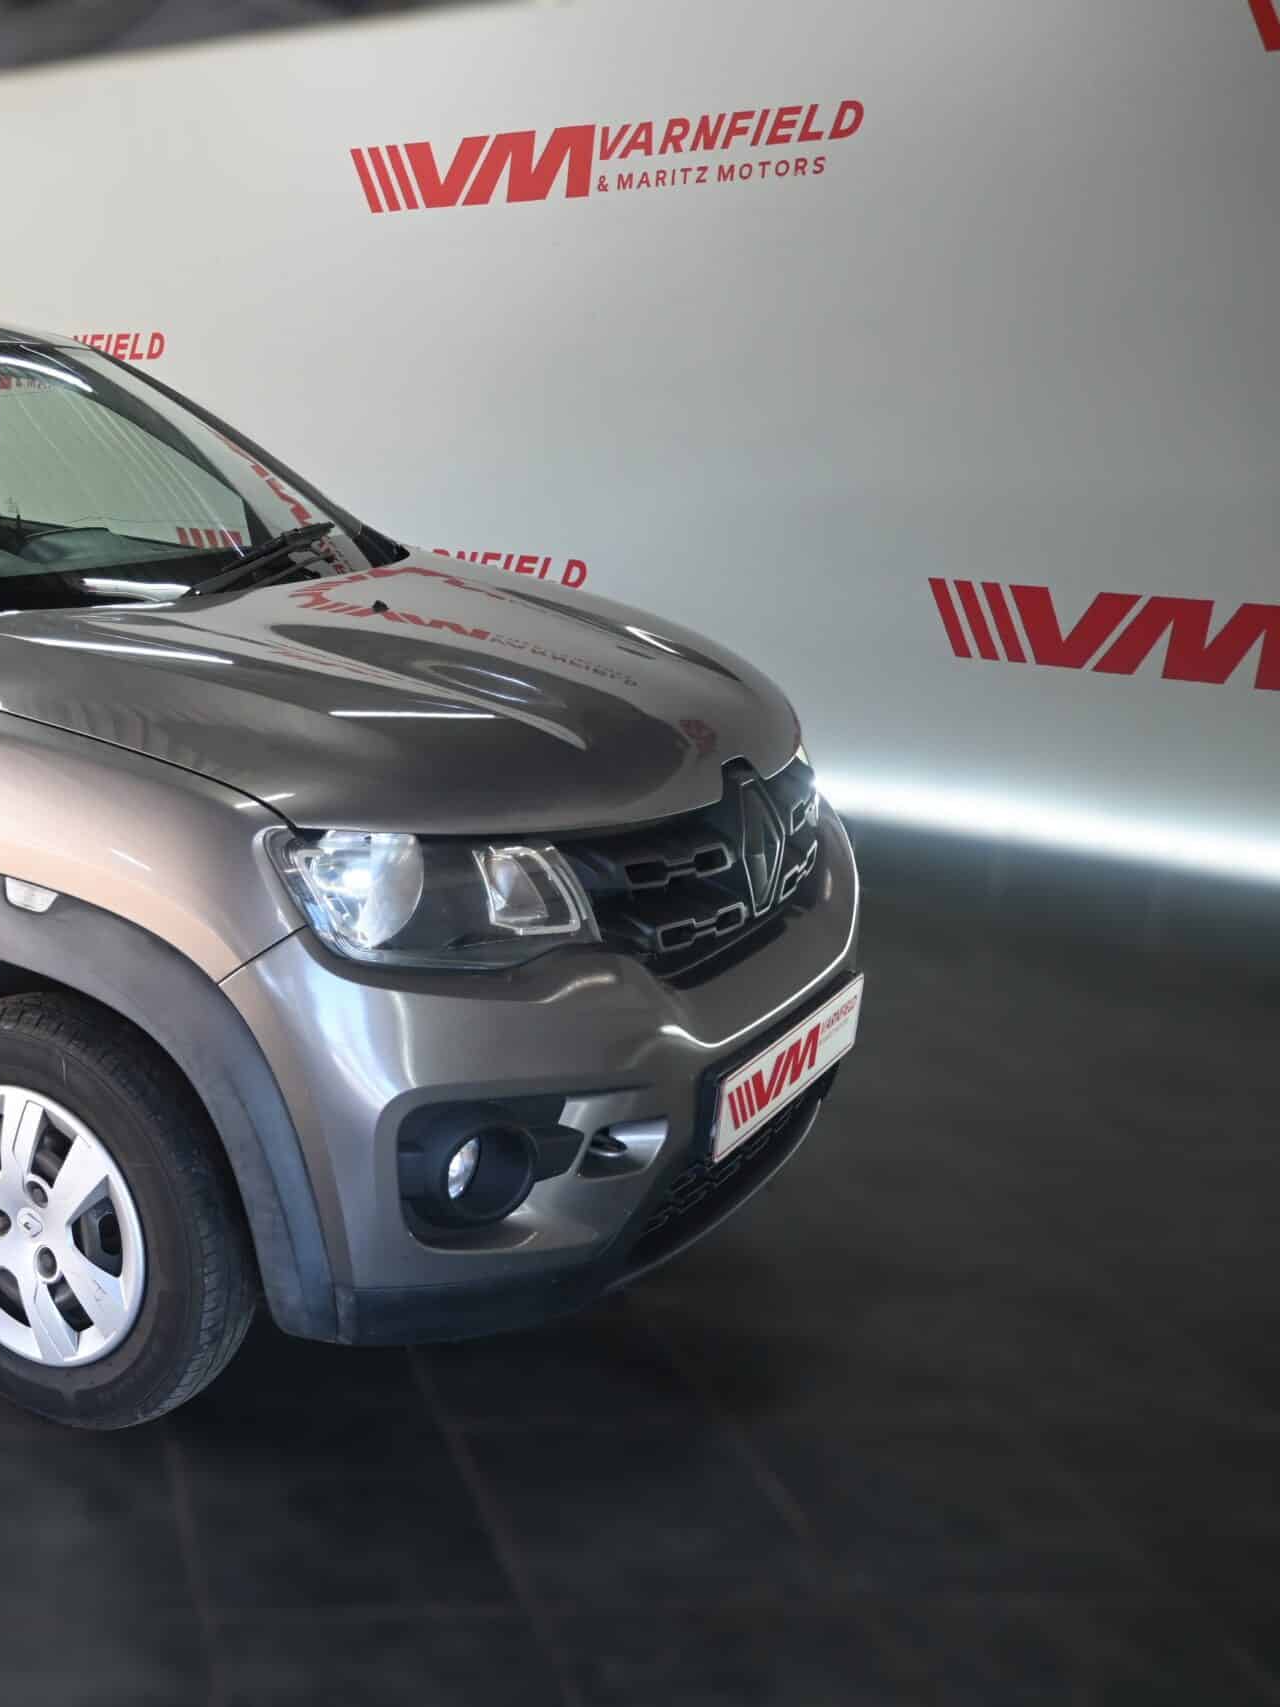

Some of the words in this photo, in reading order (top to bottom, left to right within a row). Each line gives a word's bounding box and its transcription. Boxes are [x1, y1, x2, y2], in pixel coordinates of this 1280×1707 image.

[404, 123, 596, 209] VM
[598, 99, 865, 161] VARNFIELD
[596, 175, 610, 193] &
[616, 165, 710, 191] MARITZ
[716, 155, 827, 183] MOTORS
[1008, 584, 1280, 692] VM
[751, 1022, 820, 1112] VM
